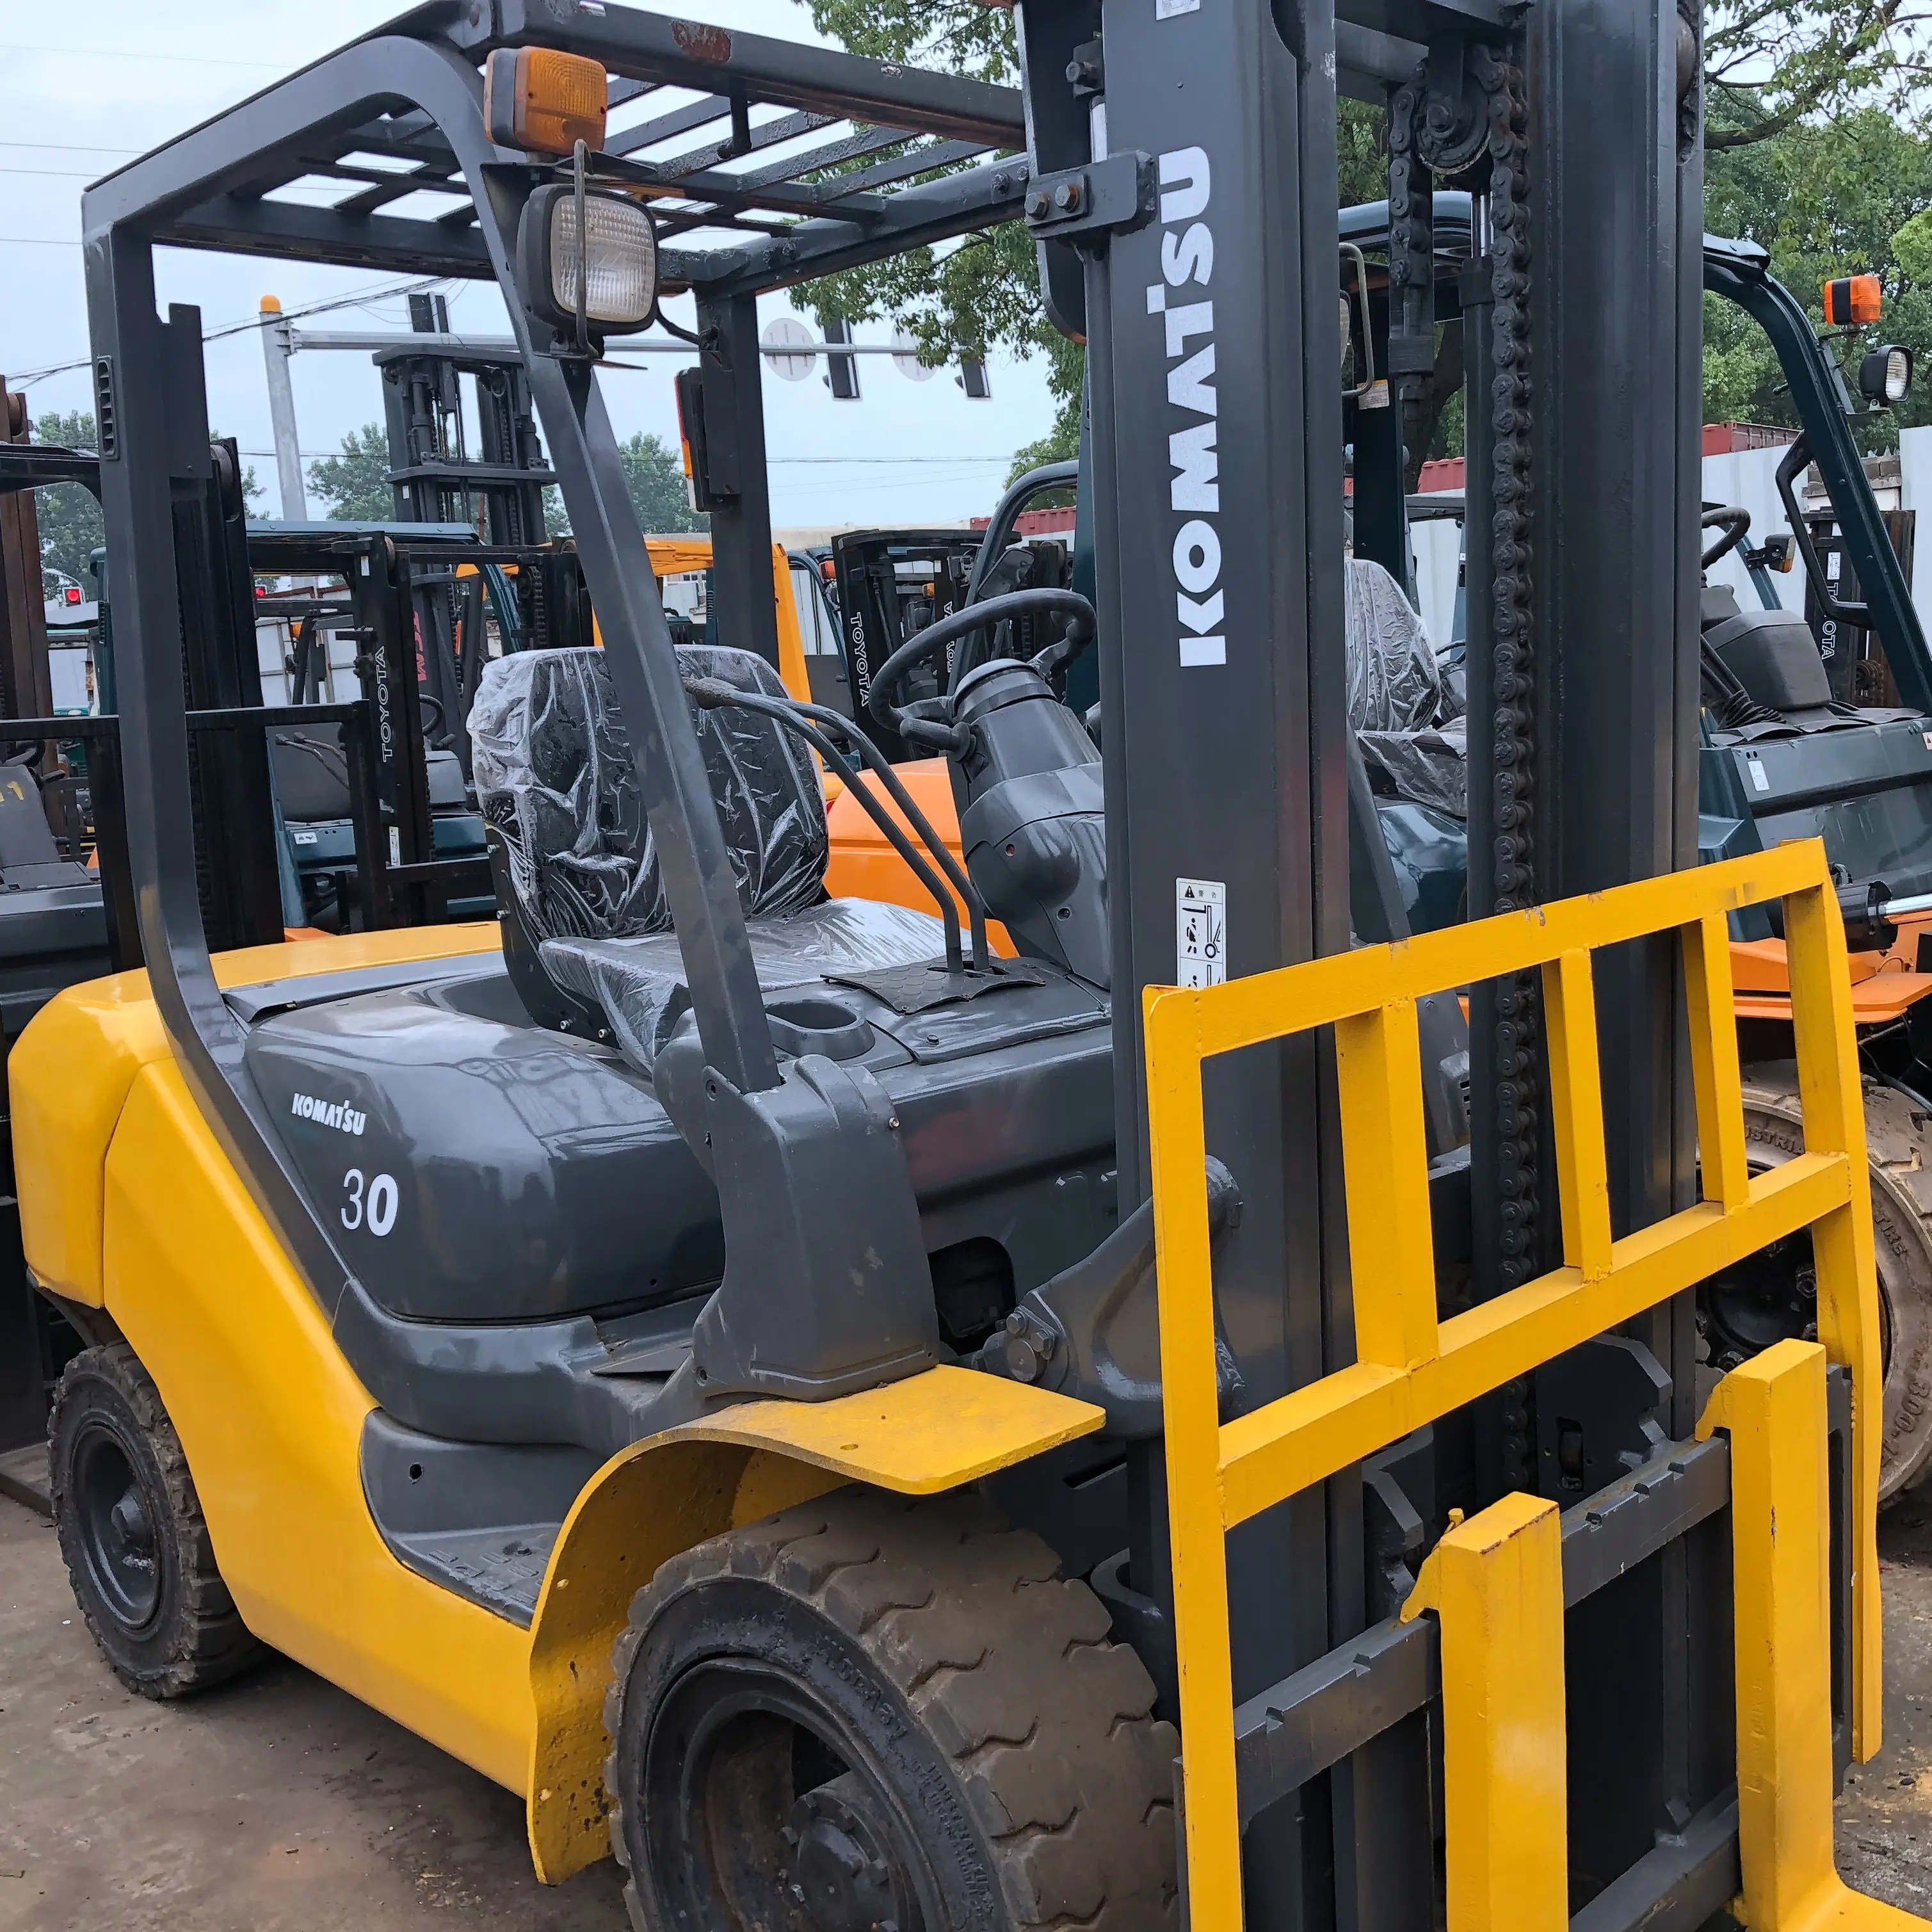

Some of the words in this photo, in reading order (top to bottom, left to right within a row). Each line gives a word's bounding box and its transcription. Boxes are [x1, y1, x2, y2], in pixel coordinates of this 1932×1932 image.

[1146, 145, 1227, 668] KOMATSU
[850, 611, 871, 707] TOYOTA
[1821, 582, 1839, 660] TOTA
[374, 645, 393, 763] TOYOTA
[291, 1093, 367, 1136] KOMATSU
[341, 1168, 399, 1237] 30
